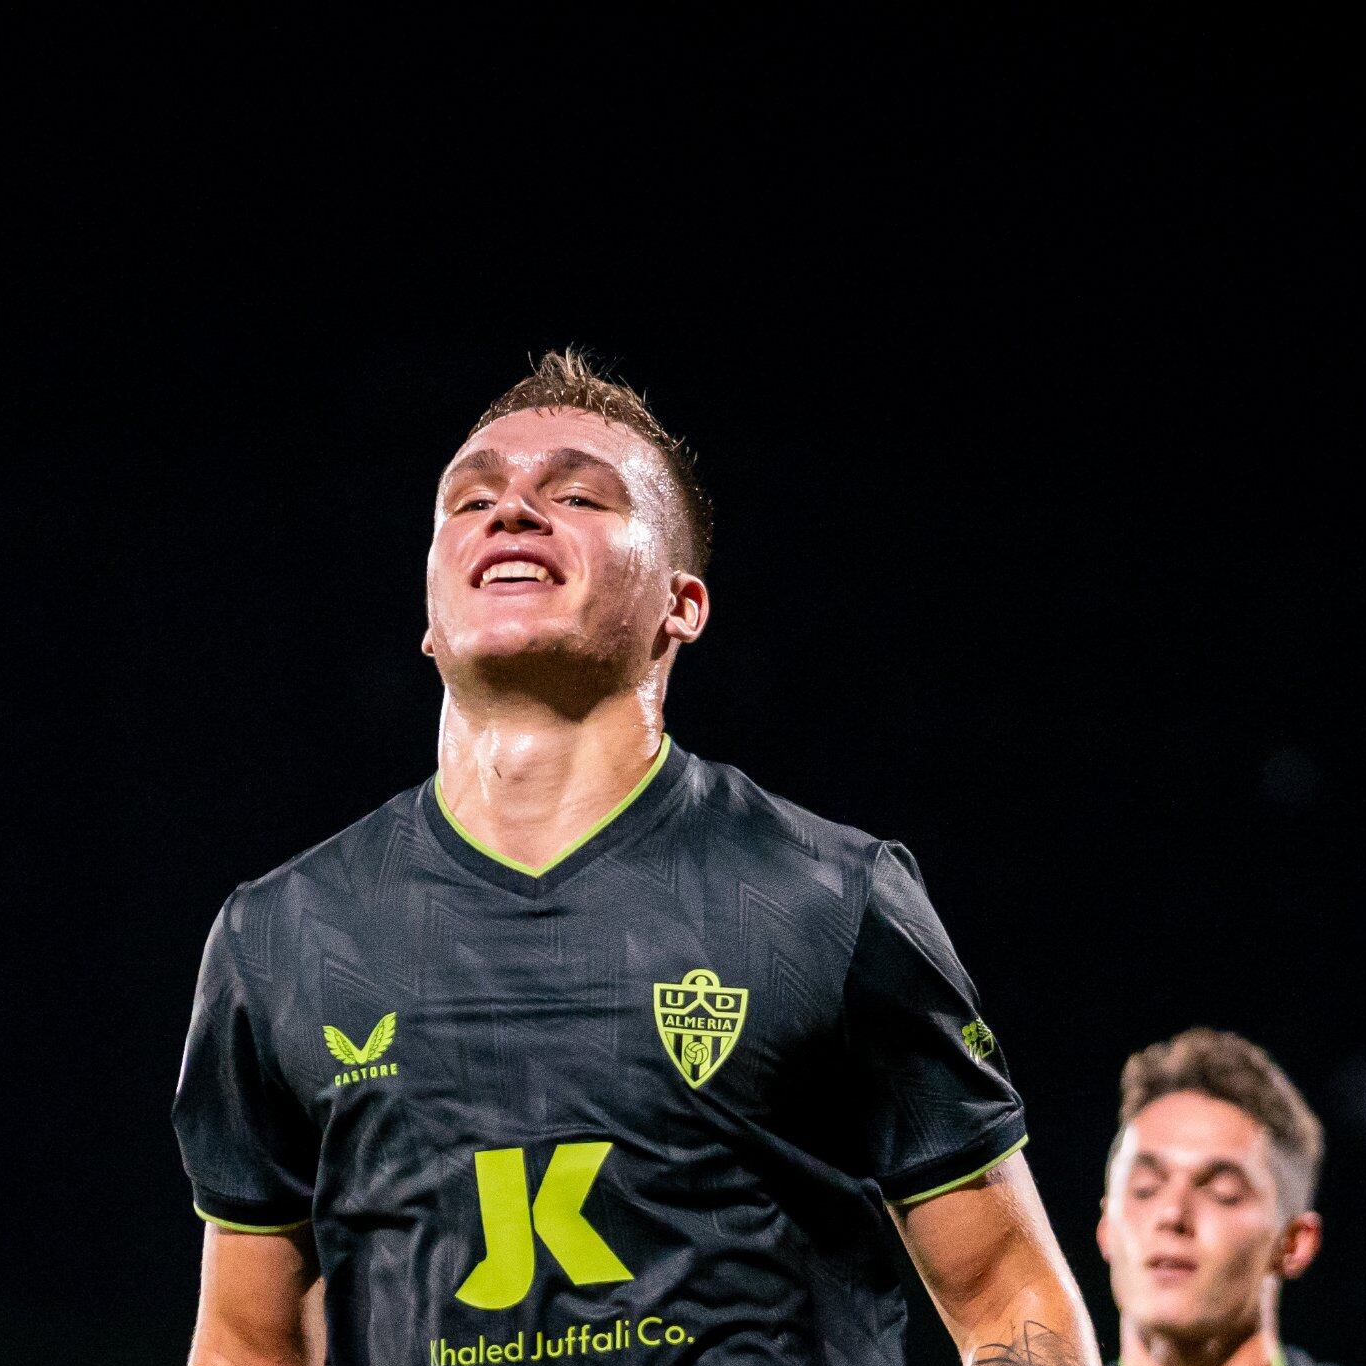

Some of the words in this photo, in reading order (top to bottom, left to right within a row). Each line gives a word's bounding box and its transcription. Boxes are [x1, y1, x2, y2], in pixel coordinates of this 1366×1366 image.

[664, 1014, 733, 1031] ALMERIA
[334, 1063, 398, 1087] CASTORE
[454, 1142, 634, 1310] JK
[531, 1320, 631, 1360] Juffali
[637, 1316, 695, 1347] Co.
